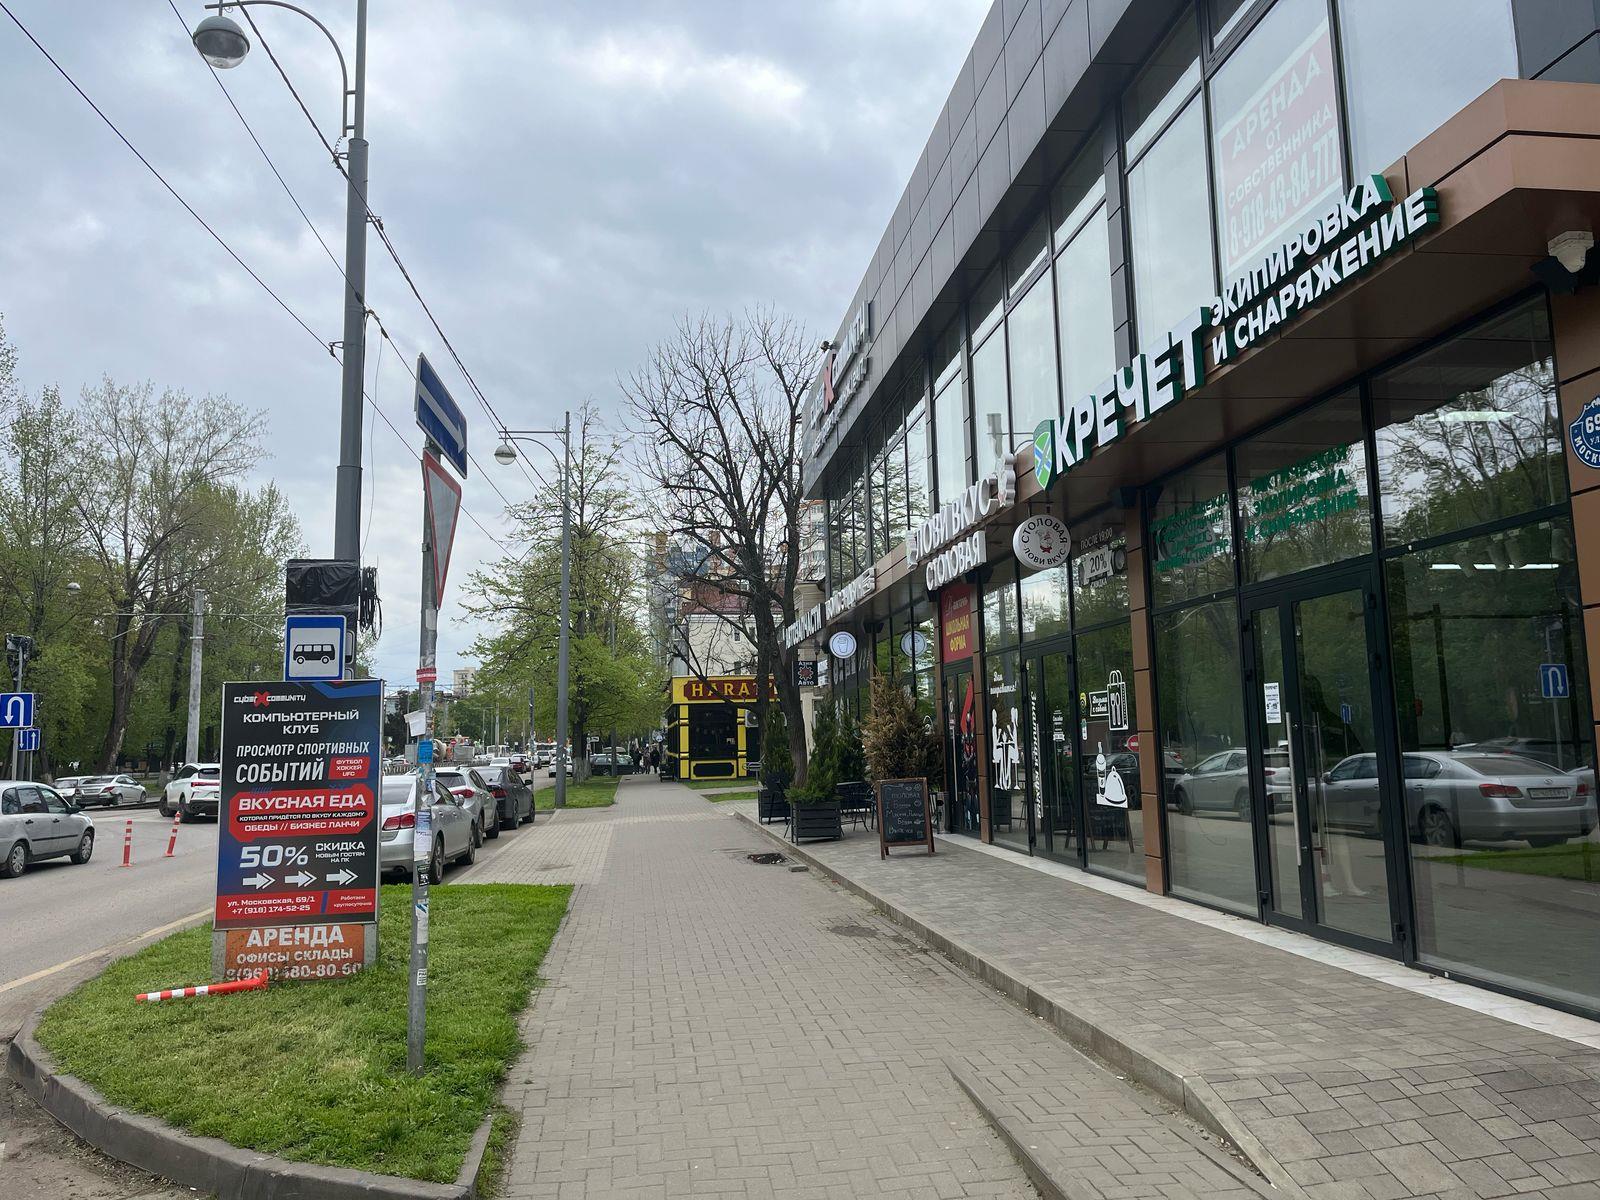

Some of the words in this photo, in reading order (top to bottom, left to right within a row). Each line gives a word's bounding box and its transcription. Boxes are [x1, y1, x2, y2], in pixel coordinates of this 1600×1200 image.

[1232, 53, 1323, 158] АРЕНДА
[1265, 124, 1283, 150] ОТ
[1228, 103, 1333, 209] СОБСТВЕННИКА
[1211, 174, 1388, 326] ЭКИПИРОВКА
[1212, 330, 1229, 365] И
[1234, 187, 1434, 349] СНАРЯЖЕНИЕ
[1053, 307, 1209, 474] КРЕЧЕТ
[915, 505, 950, 562] ЛОВИ
[951, 478, 999, 537] ВКУС
[1022, 518, 1067, 543] СТОЛОВАЯ
[926, 530, 987, 591] СТОЛОВАЯ
[1024, 548, 1045, 565] ЛОВИ
[1047, 549, 1066, 565] ВКУС
[1090, 552, 1107, 573] 20%
[243, 709, 359, 723] КОМПЬЮТЕРНЫЙ
[283, 725, 319, 734] КЛУБ
[236, 744, 293, 757] ПРОСМОТР
[297, 741, 370, 755] СПОРТИВНЫХ
[236, 757, 324, 783] СОБЫТИЙ
[238, 796, 324, 811] ВКУСНАЯ
[329, 794, 366, 808] ЕДА
[244, 824, 278, 832] ОБЕДЫ
[290, 822, 327, 830] БИЗНЕС
[328, 821, 360, 829] ЛАНЧИ
[239, 845, 309, 868] 50%
[315, 841, 365, 852] СКИДКА
[241, 897, 294, 906] Московская,
[296, 895, 315, 903] 69/1
[268, 904, 311, 912] 174-52-25
[246, 925, 344, 948] АРЕНДА
[236, 950, 290, 964] ОФИСЫ
[294, 948, 353, 961] СКЛАДЫ
